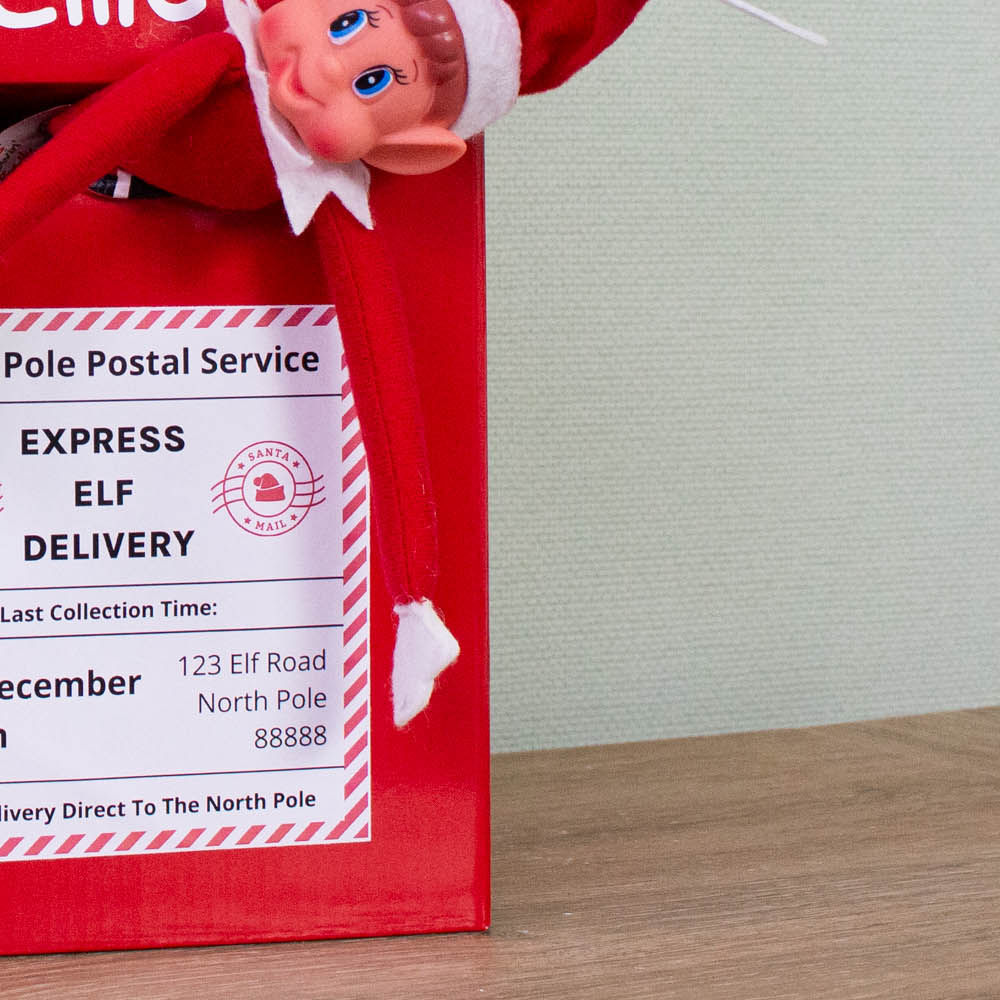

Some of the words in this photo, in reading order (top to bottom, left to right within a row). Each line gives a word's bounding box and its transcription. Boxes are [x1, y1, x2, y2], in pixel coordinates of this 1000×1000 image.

[4, 349, 76, 379] Pole
[88, 346, 190, 377] Postal
[201, 344, 320, 375] Service
[20, 425, 186, 456] EXPRESS
[247, 447, 291, 462] SANTA
[74, 479, 134, 507] ELF
[255, 519, 288, 532] MAIL
[24, 529, 195, 562] DELIVERY
[0, 605, 44, 623] Last
[50, 601, 154, 622] Collection
[160, 599, 218, 618] Time:
[178, 654, 222, 677] 123
[231, 651, 261, 675] Elf
[267, 648, 327, 673] Road
[198, 689, 268, 714] North
[277, 686, 328, 710] Pole
[254, 724, 328, 749] 88888
[62, 800, 126, 820] Direct
[131, 798, 157, 816] To
[162, 796, 200, 815] The
[206, 792, 266, 813] North
[273, 790, 317, 809] Pole
